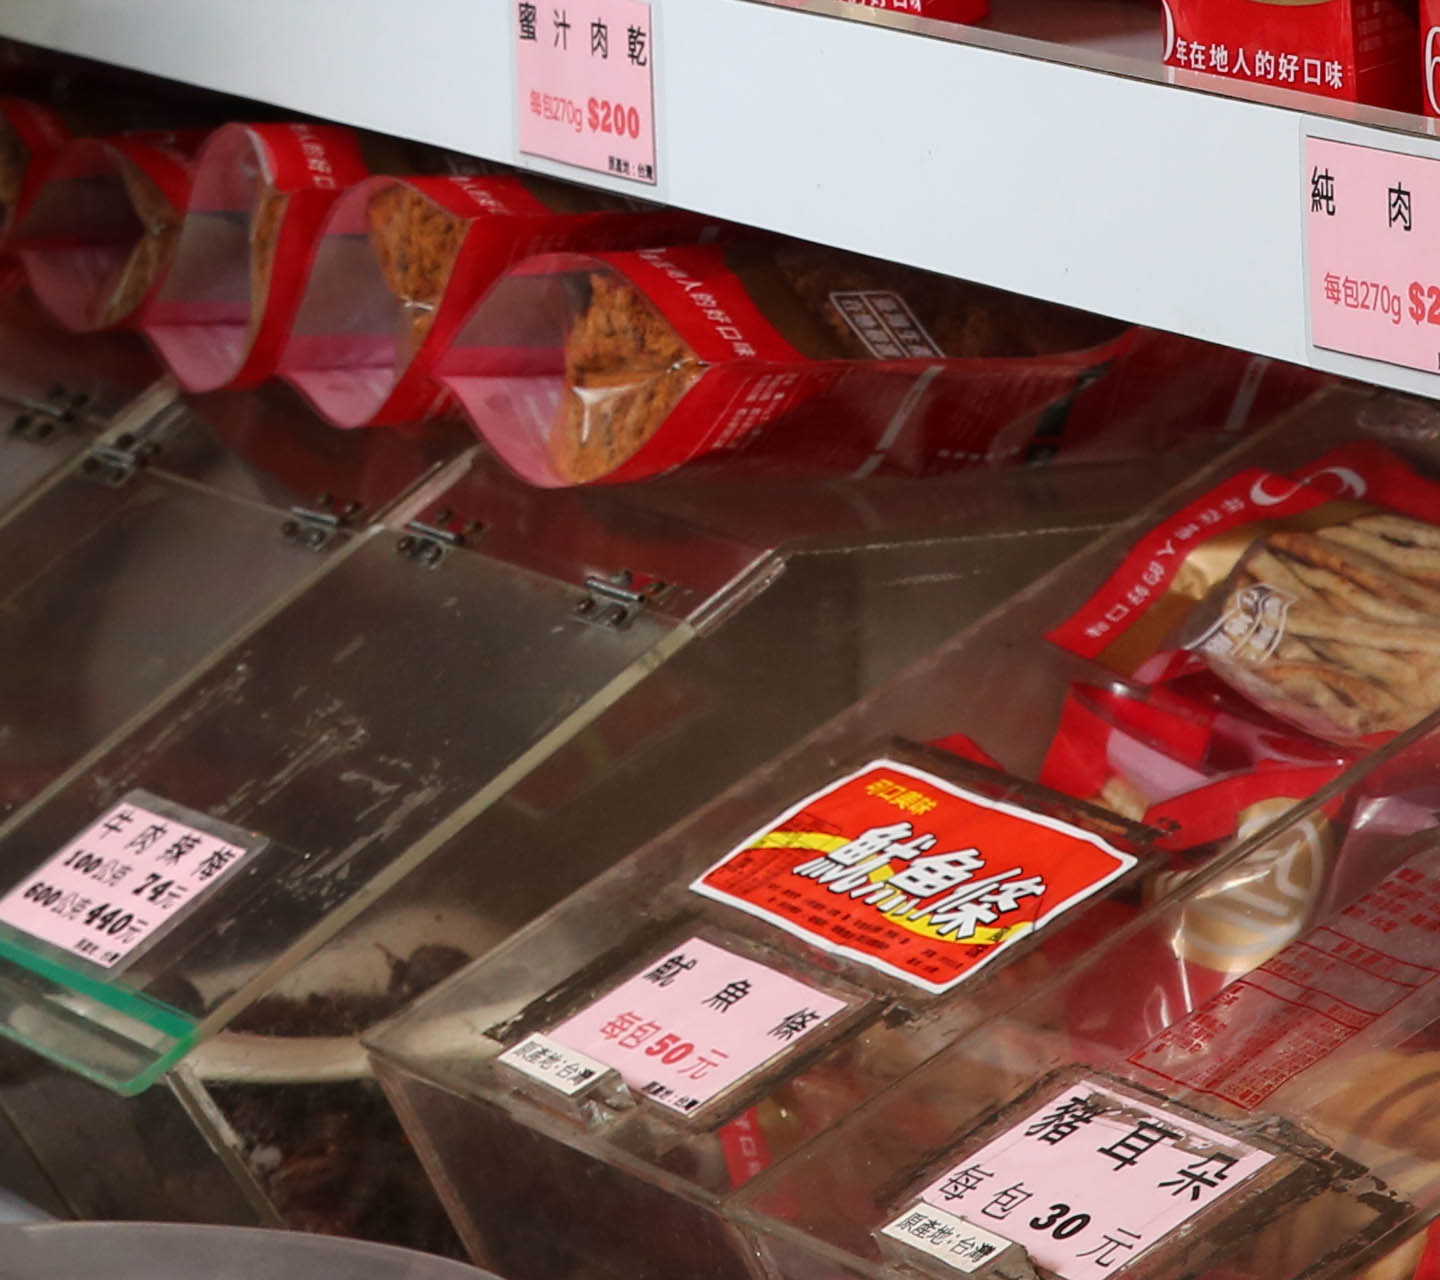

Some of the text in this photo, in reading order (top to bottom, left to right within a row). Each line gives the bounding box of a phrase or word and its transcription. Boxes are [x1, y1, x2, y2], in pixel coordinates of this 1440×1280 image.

[518, 1, 647, 67] 蜜汁肉乾
[587, 96, 640, 139] $200
[1324, 272, 1401, 324] 每包270g
[864, 779, 939, 816] 可口美味
[63, 848, 188, 909] 100公克 74元
[792, 821, 1047, 941] 魷魚條
[23, 880, 149, 944] 600公克 440元
[642, 952, 822, 1042] 魷魚條
[598, 1011, 730, 1082] 每包50元
[1023, 1095, 1241, 1202] 豬耳朵
[937, 1162, 1144, 1269] 每包30元
